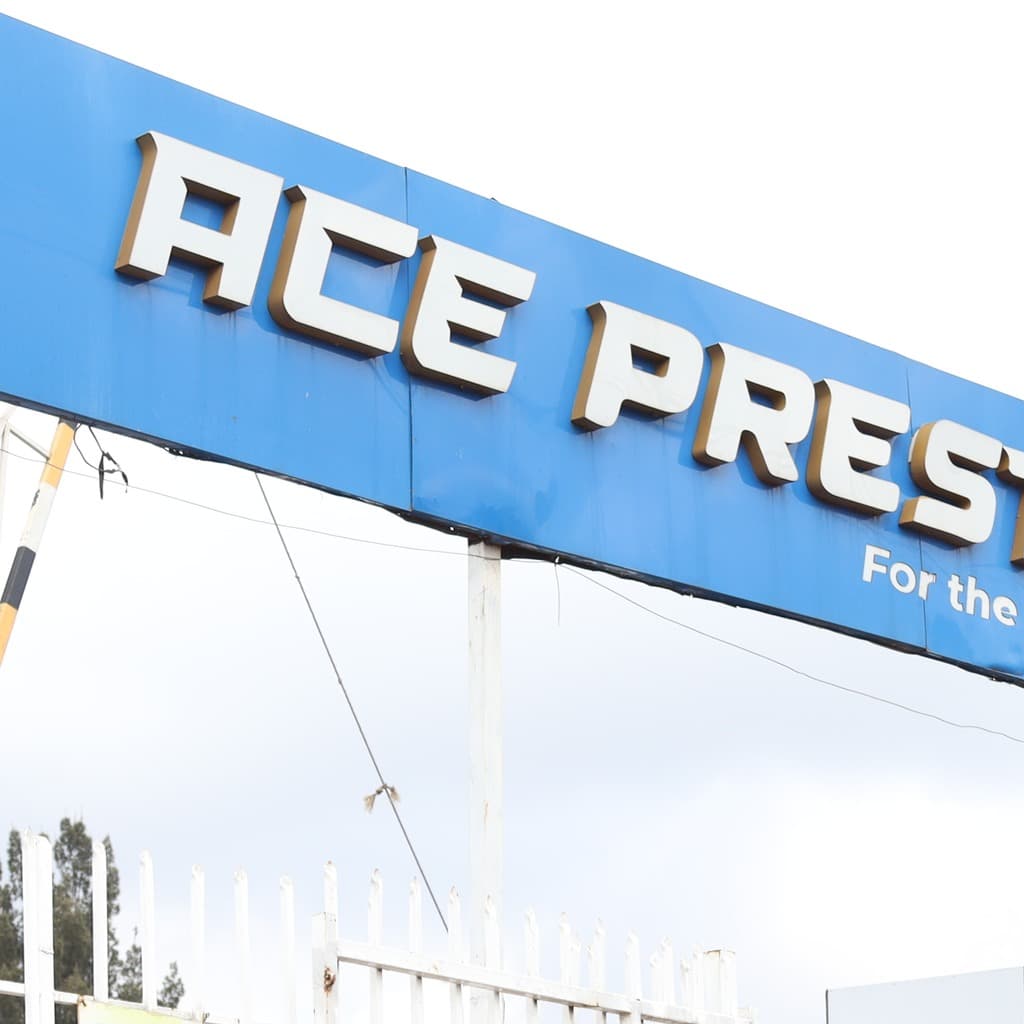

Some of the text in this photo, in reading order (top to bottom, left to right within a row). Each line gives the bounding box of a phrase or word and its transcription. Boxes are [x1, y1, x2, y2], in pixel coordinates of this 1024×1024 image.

[115, 130, 537, 400] ACE
[861, 543, 936, 601] For
[947, 573, 1019, 626] the
